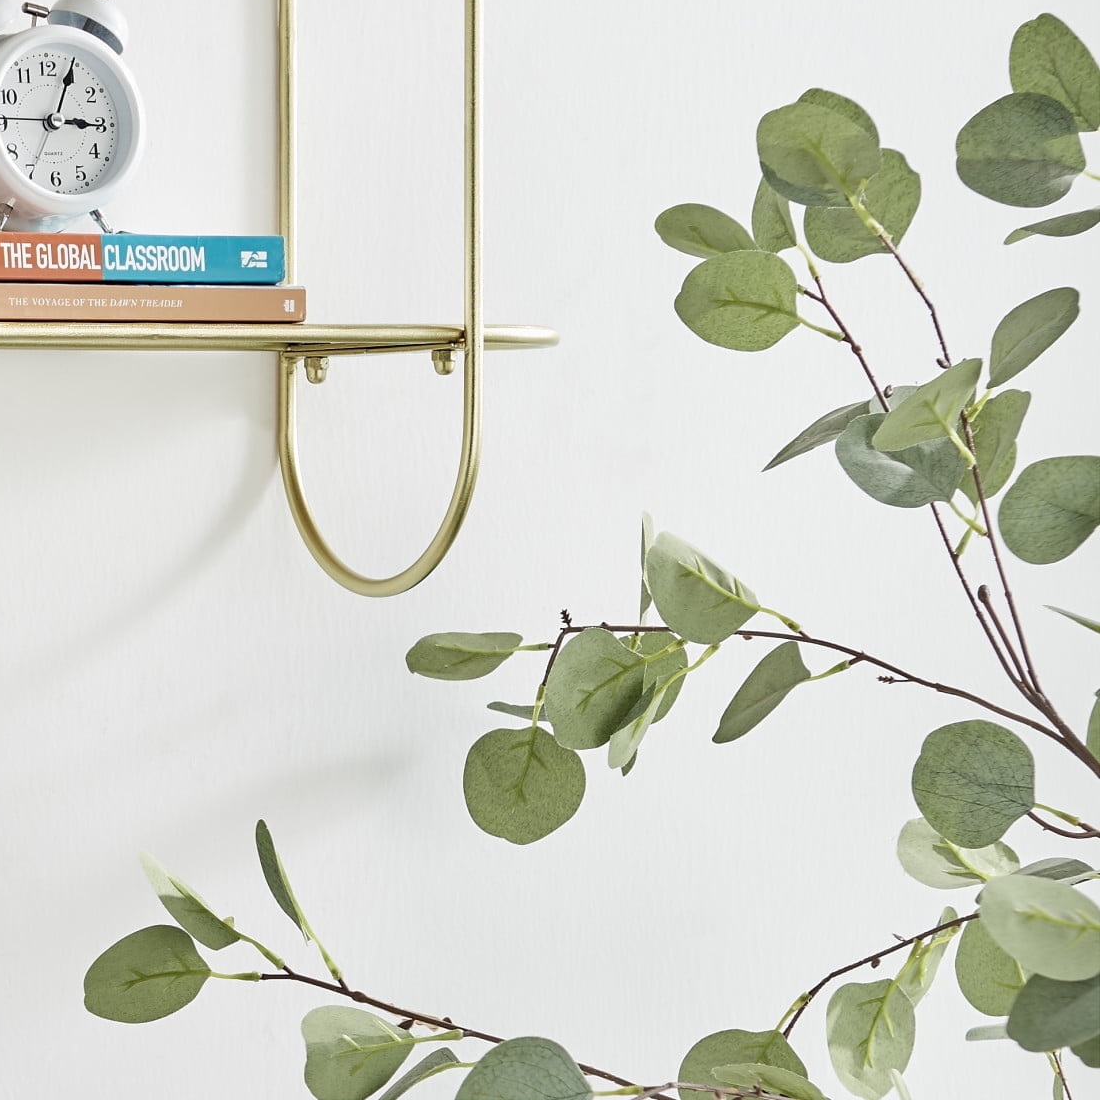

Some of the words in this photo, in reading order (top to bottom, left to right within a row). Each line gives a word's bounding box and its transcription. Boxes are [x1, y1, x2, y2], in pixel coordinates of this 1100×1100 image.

[17, 68, 31, 84] 11
[38, 60, 57, 77] 12
[1, 88, 17, 105] 10
[85, 87, 97, 103] 2
[7, 143, 18, 160] 8
[88, 143, 101, 159] 4
[25, 164, 36, 180] 7
[50, 170, 62, 187] 6
[76, 165, 87, 181] 5
[0, 242, 33, 269] THE
[36, 243, 102, 270] GLOBAL
[104, 244, 206, 272] CLASSROOM
[8, 296, 29, 306] THE
[31, 296, 72, 306] VOYAGE
[73, 297, 86, 306] OF
[87, 297, 108, 307] THE
[109, 298, 138, 307] DAWN
[139, 298, 183, 308] TREADER
